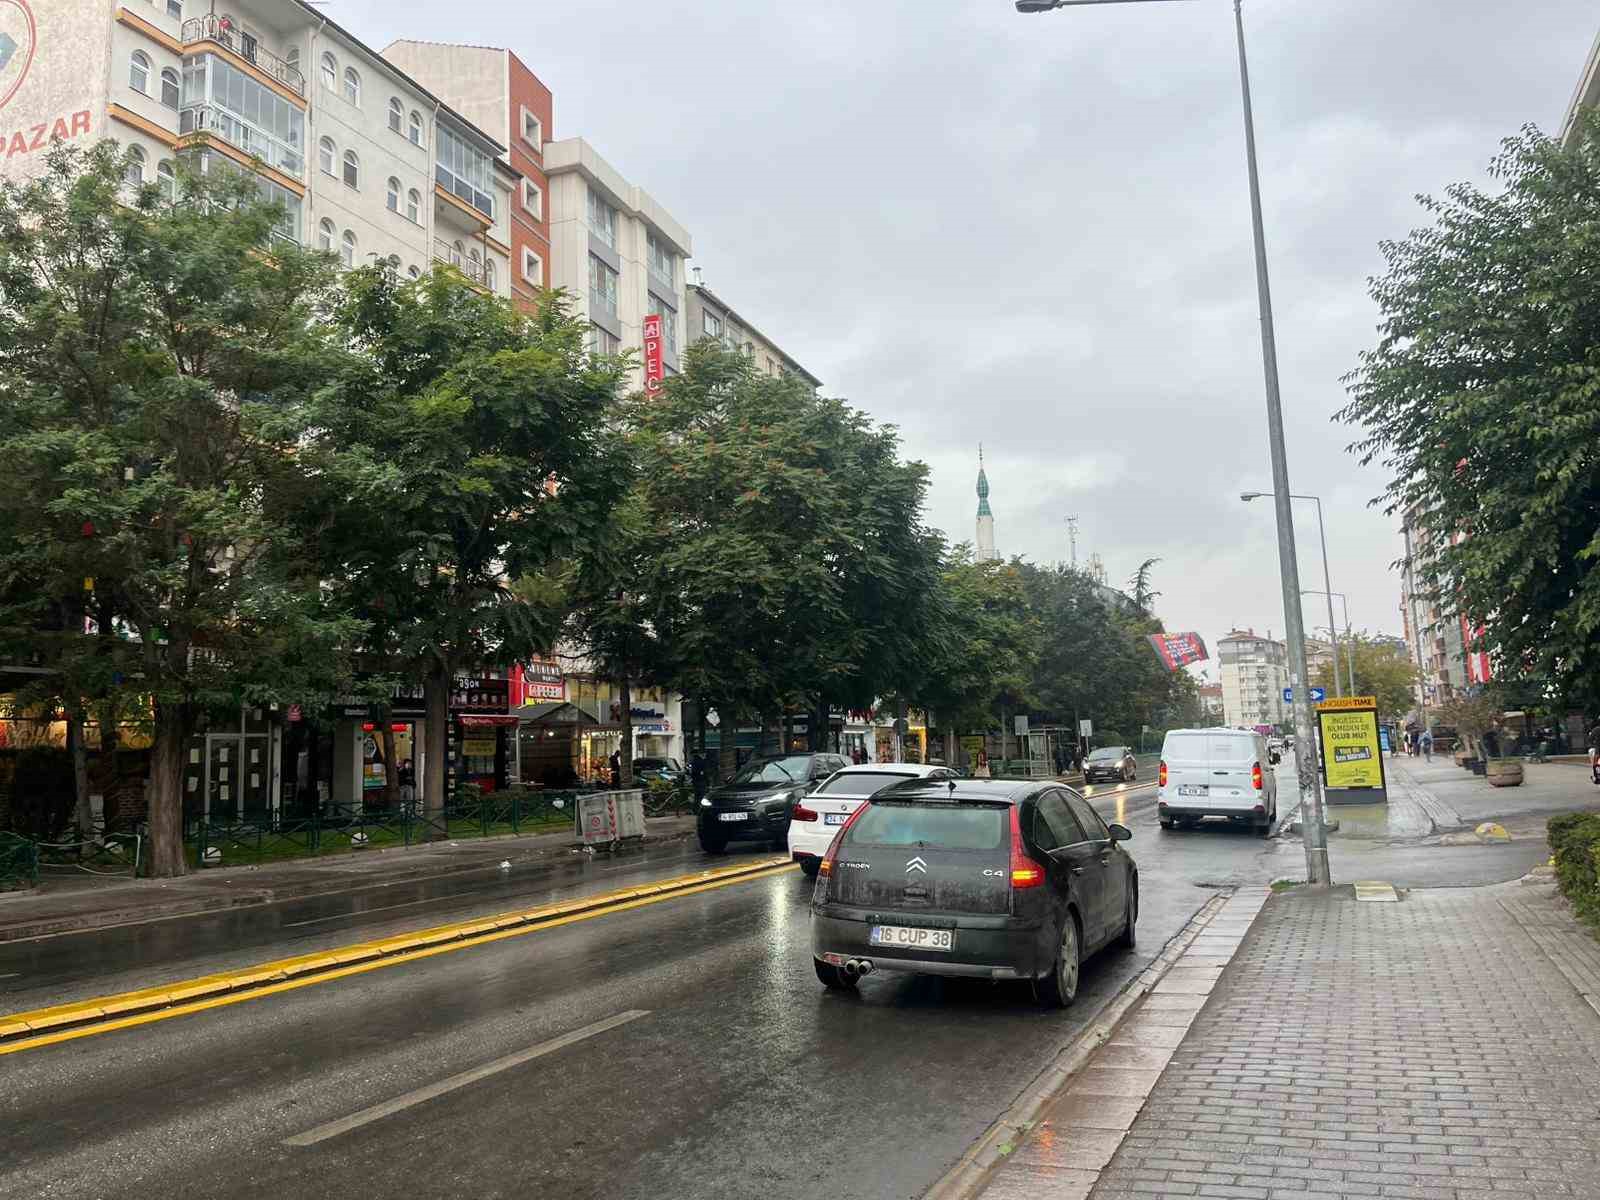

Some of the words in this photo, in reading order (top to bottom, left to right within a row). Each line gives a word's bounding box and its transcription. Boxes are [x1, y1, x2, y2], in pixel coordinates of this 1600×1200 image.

[647, 341, 659, 401] PEC
[1353, 698, 1372, 706] TIME
[839, 862, 871, 870] CTROEN
[983, 869, 1004, 877] C4
[880, 927, 893, 942] 16
[898, 928, 928, 944] CUP
[932, 931, 950, 947] 38
